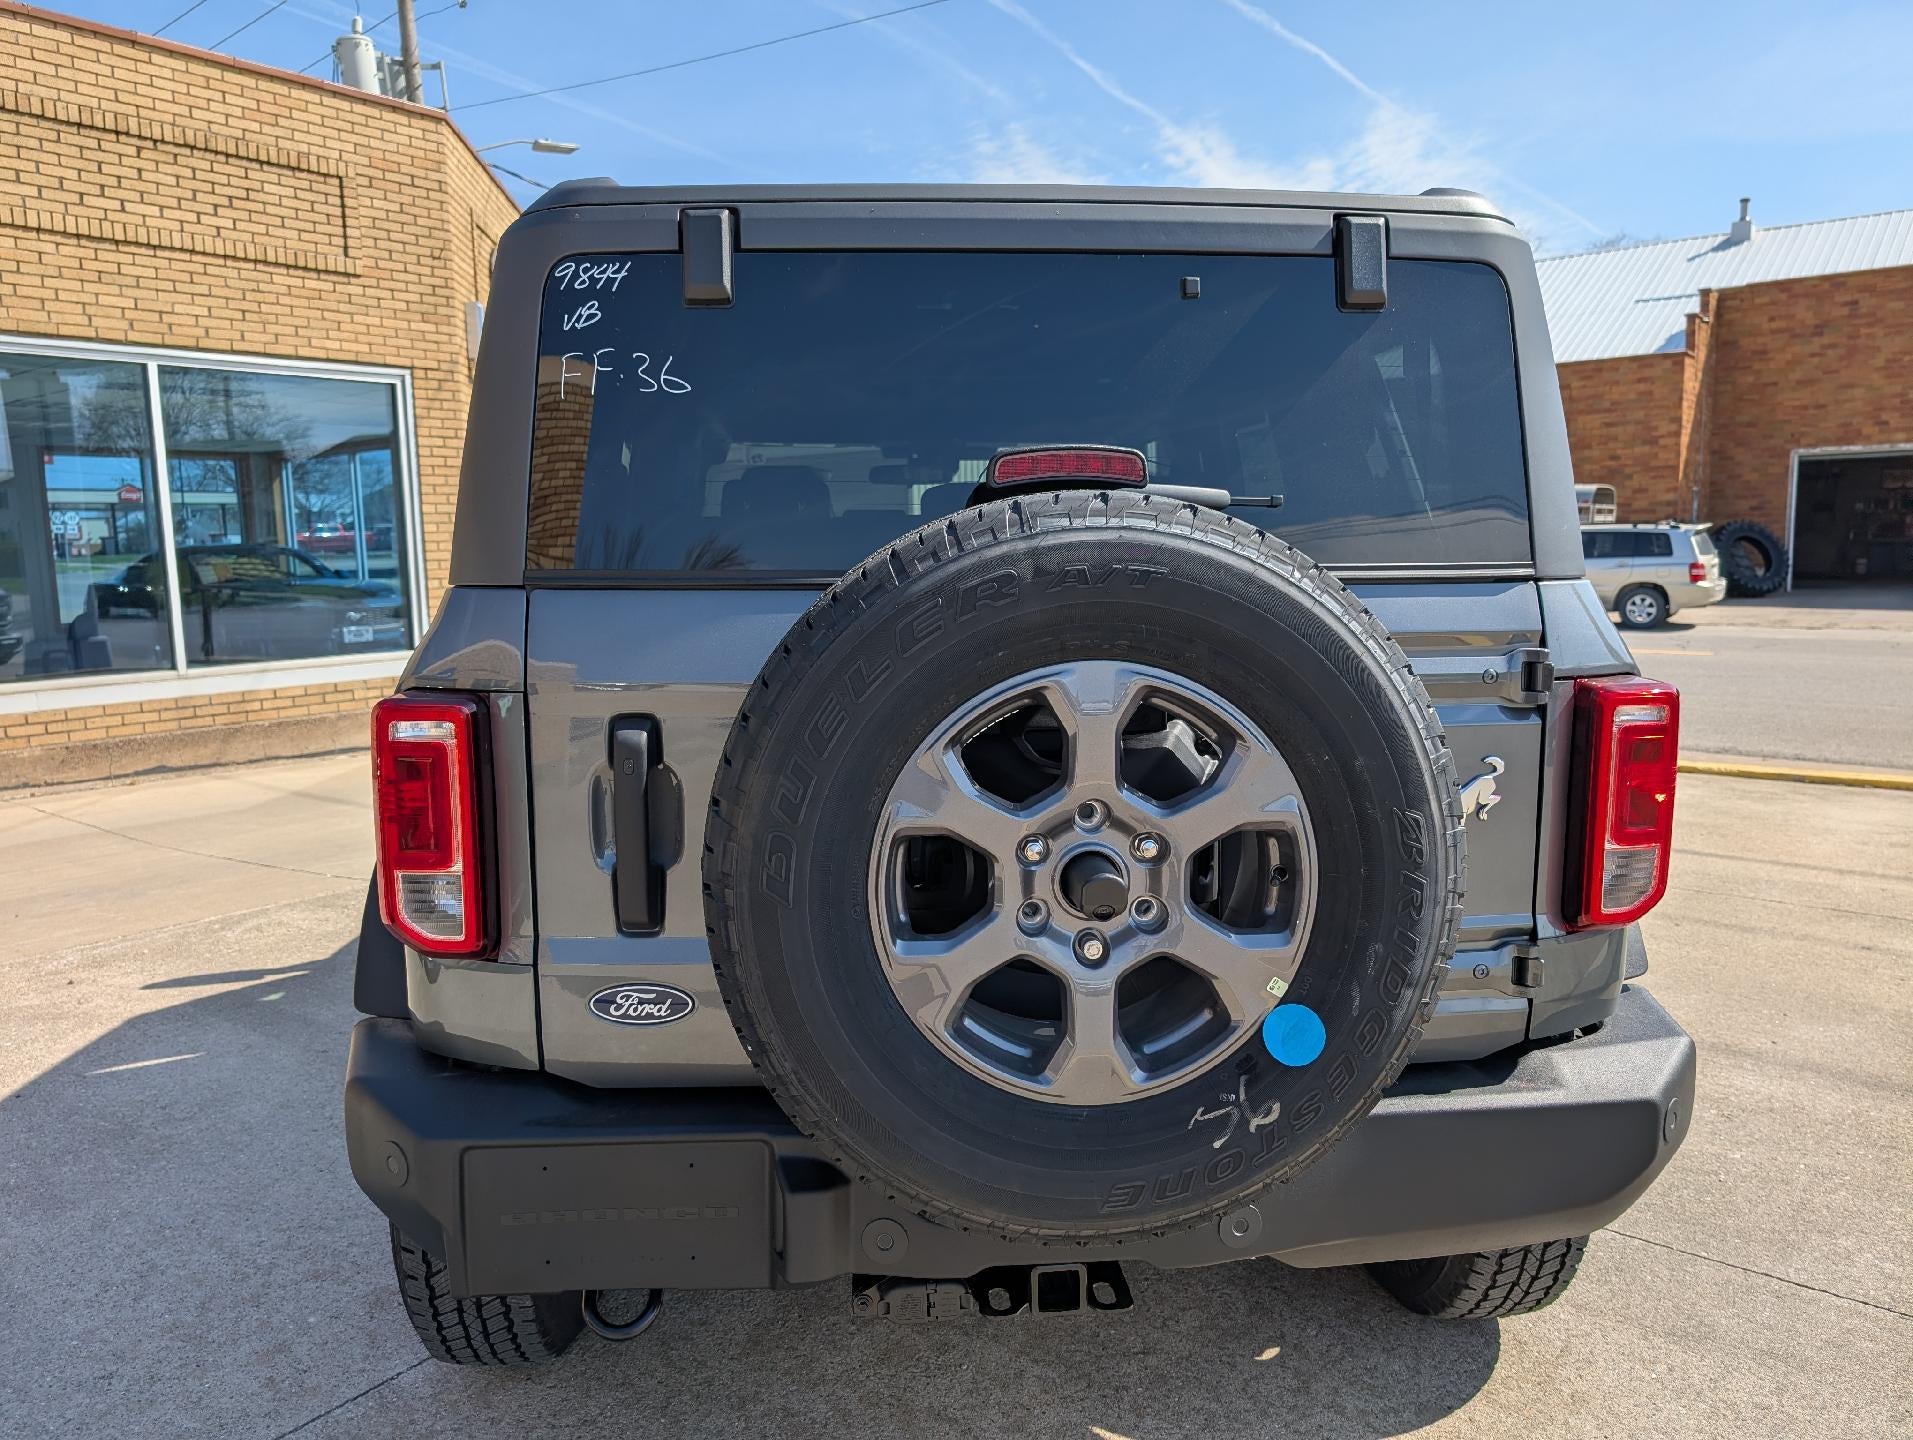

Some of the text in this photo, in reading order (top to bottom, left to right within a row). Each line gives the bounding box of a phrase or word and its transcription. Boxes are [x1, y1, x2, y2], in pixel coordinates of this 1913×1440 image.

[554, 260, 632, 292] 9844
[760, 567, 1022, 909] DUELER
[1045, 563, 1170, 593] A/T
[609, 991, 672, 1017] Ford
[1101, 806, 1432, 1213] BRIDGESTONE
